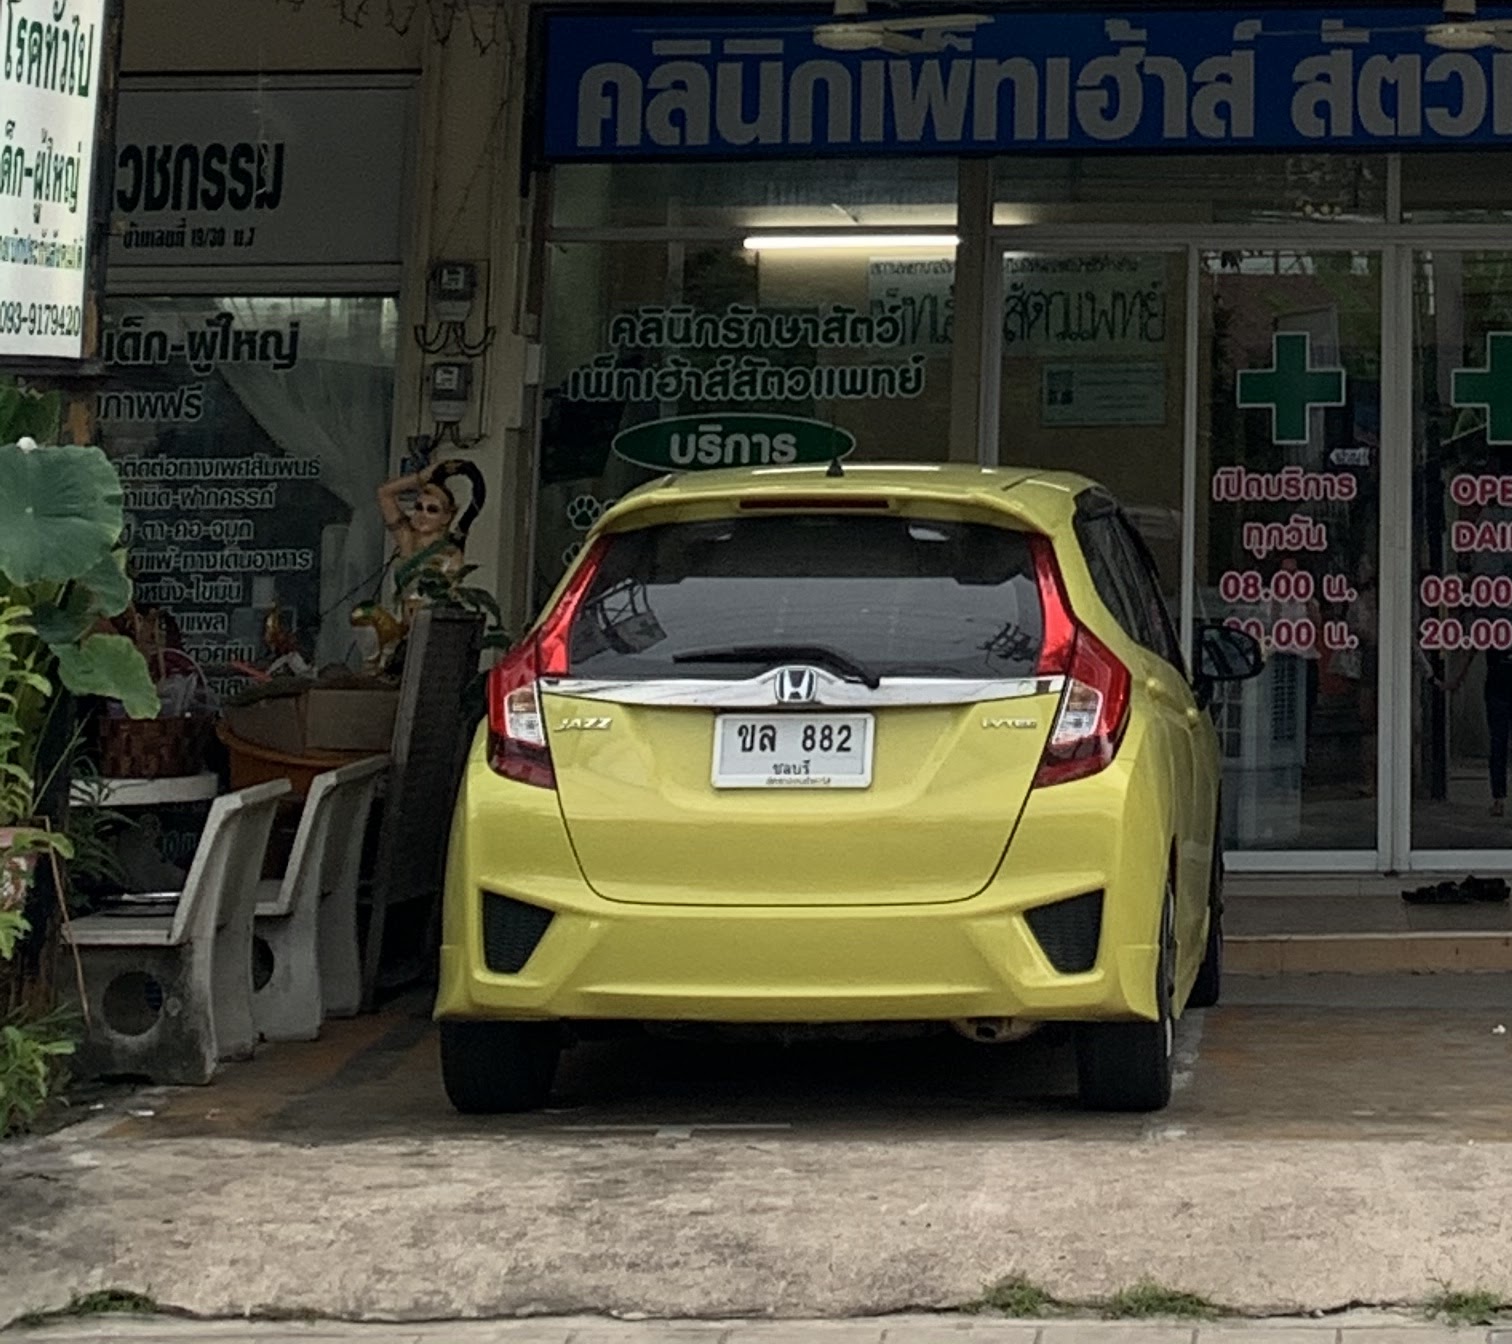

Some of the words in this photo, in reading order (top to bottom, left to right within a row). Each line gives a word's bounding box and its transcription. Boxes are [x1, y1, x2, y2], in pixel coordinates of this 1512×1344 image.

[577, 18, 1262, 148] คลินิกเพ็ทเฮ้าส์
[0, 118, 83, 224] ด็ก-ผู้ใหญ่
[117, 142, 286, 212] วชกรรม
[103, 312, 301, 374] เด็ก-ผู้ใหญ่
[609, 304, 905, 349] คลินิกรักษาสัตว์
[567, 353, 926, 403] เพ็ทเฮ้าส์สัตวแพทย์
[97, 384, 206, 421] ภาพฟรี
[669, 424, 799, 465] บริการ
[1211, 466, 1358, 502] เปิดบริการ
[1242, 514, 1329, 560] ทุกวัน
[1219, 570, 1315, 604] 08.00
[1321, 573, 1359, 603] น.
[1321, 620, 1360, 650] น.
[554, 717, 613, 733] JAZZ
[737, 723, 778, 753] ขล
[801, 723, 853, 753] 882
